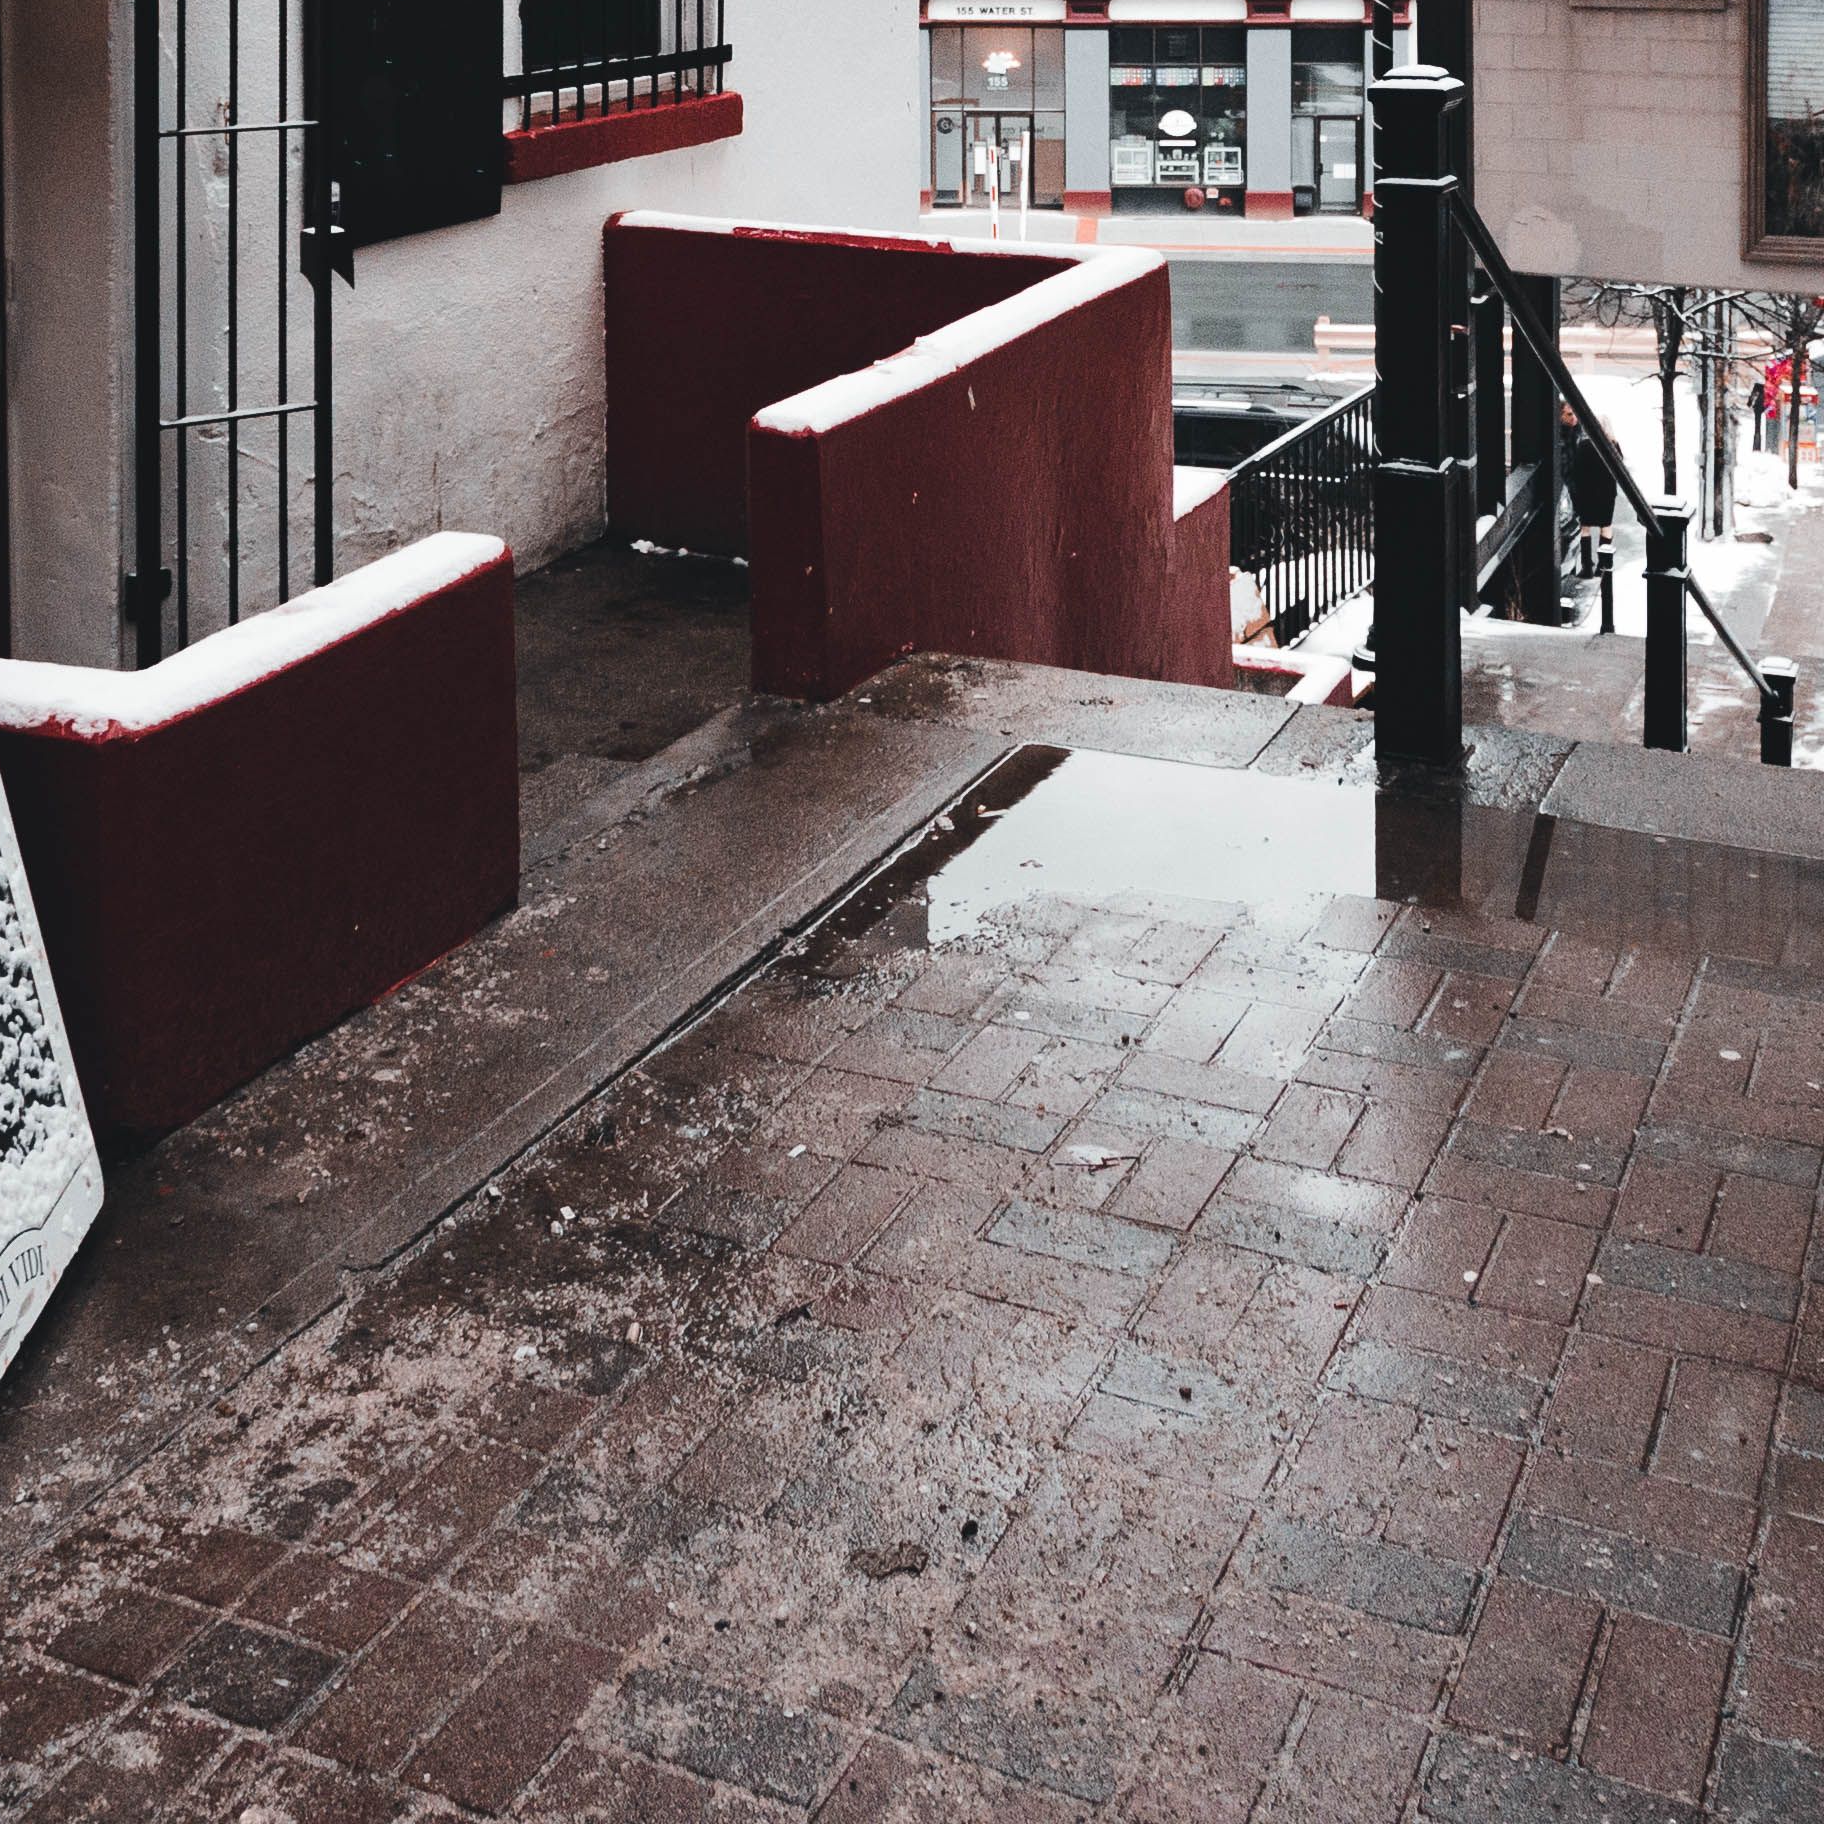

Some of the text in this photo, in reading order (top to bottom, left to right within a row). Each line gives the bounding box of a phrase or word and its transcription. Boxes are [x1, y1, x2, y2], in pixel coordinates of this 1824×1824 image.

[956, 6, 1034, 16] 155 WATER ST
[8, 1244, 45, 1288] VIDI
